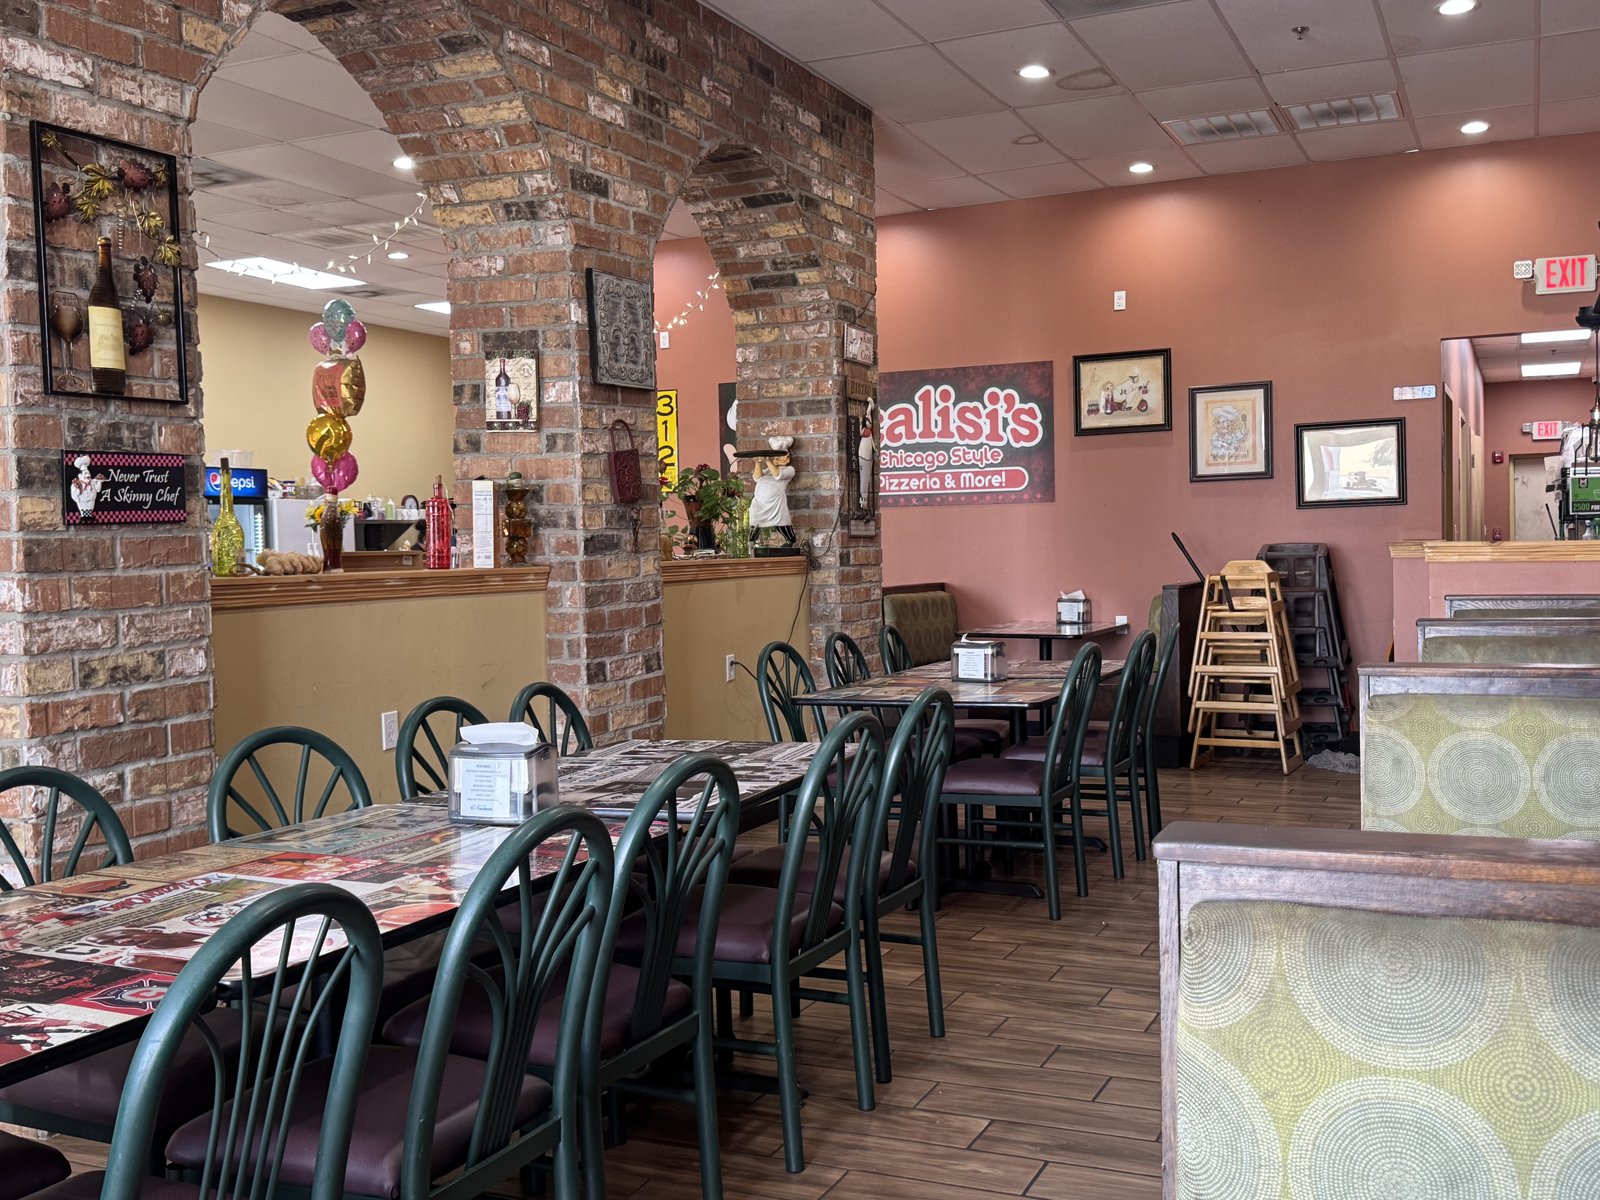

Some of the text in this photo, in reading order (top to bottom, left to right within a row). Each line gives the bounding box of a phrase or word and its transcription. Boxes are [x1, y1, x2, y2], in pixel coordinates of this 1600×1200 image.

[1545, 257, 1588, 289] EXIT
[1537, 421, 1558, 437] EXIT
[880, 446, 1003, 471] Chicago Style
[107, 468, 170, 483] Never Trust
[230, 475, 256, 491] epsi
[880, 471, 1006, 491] Pizzeria & More!
[100, 487, 181, 509] A Skinny Chef
[1573, 502, 1590, 512] 2500
